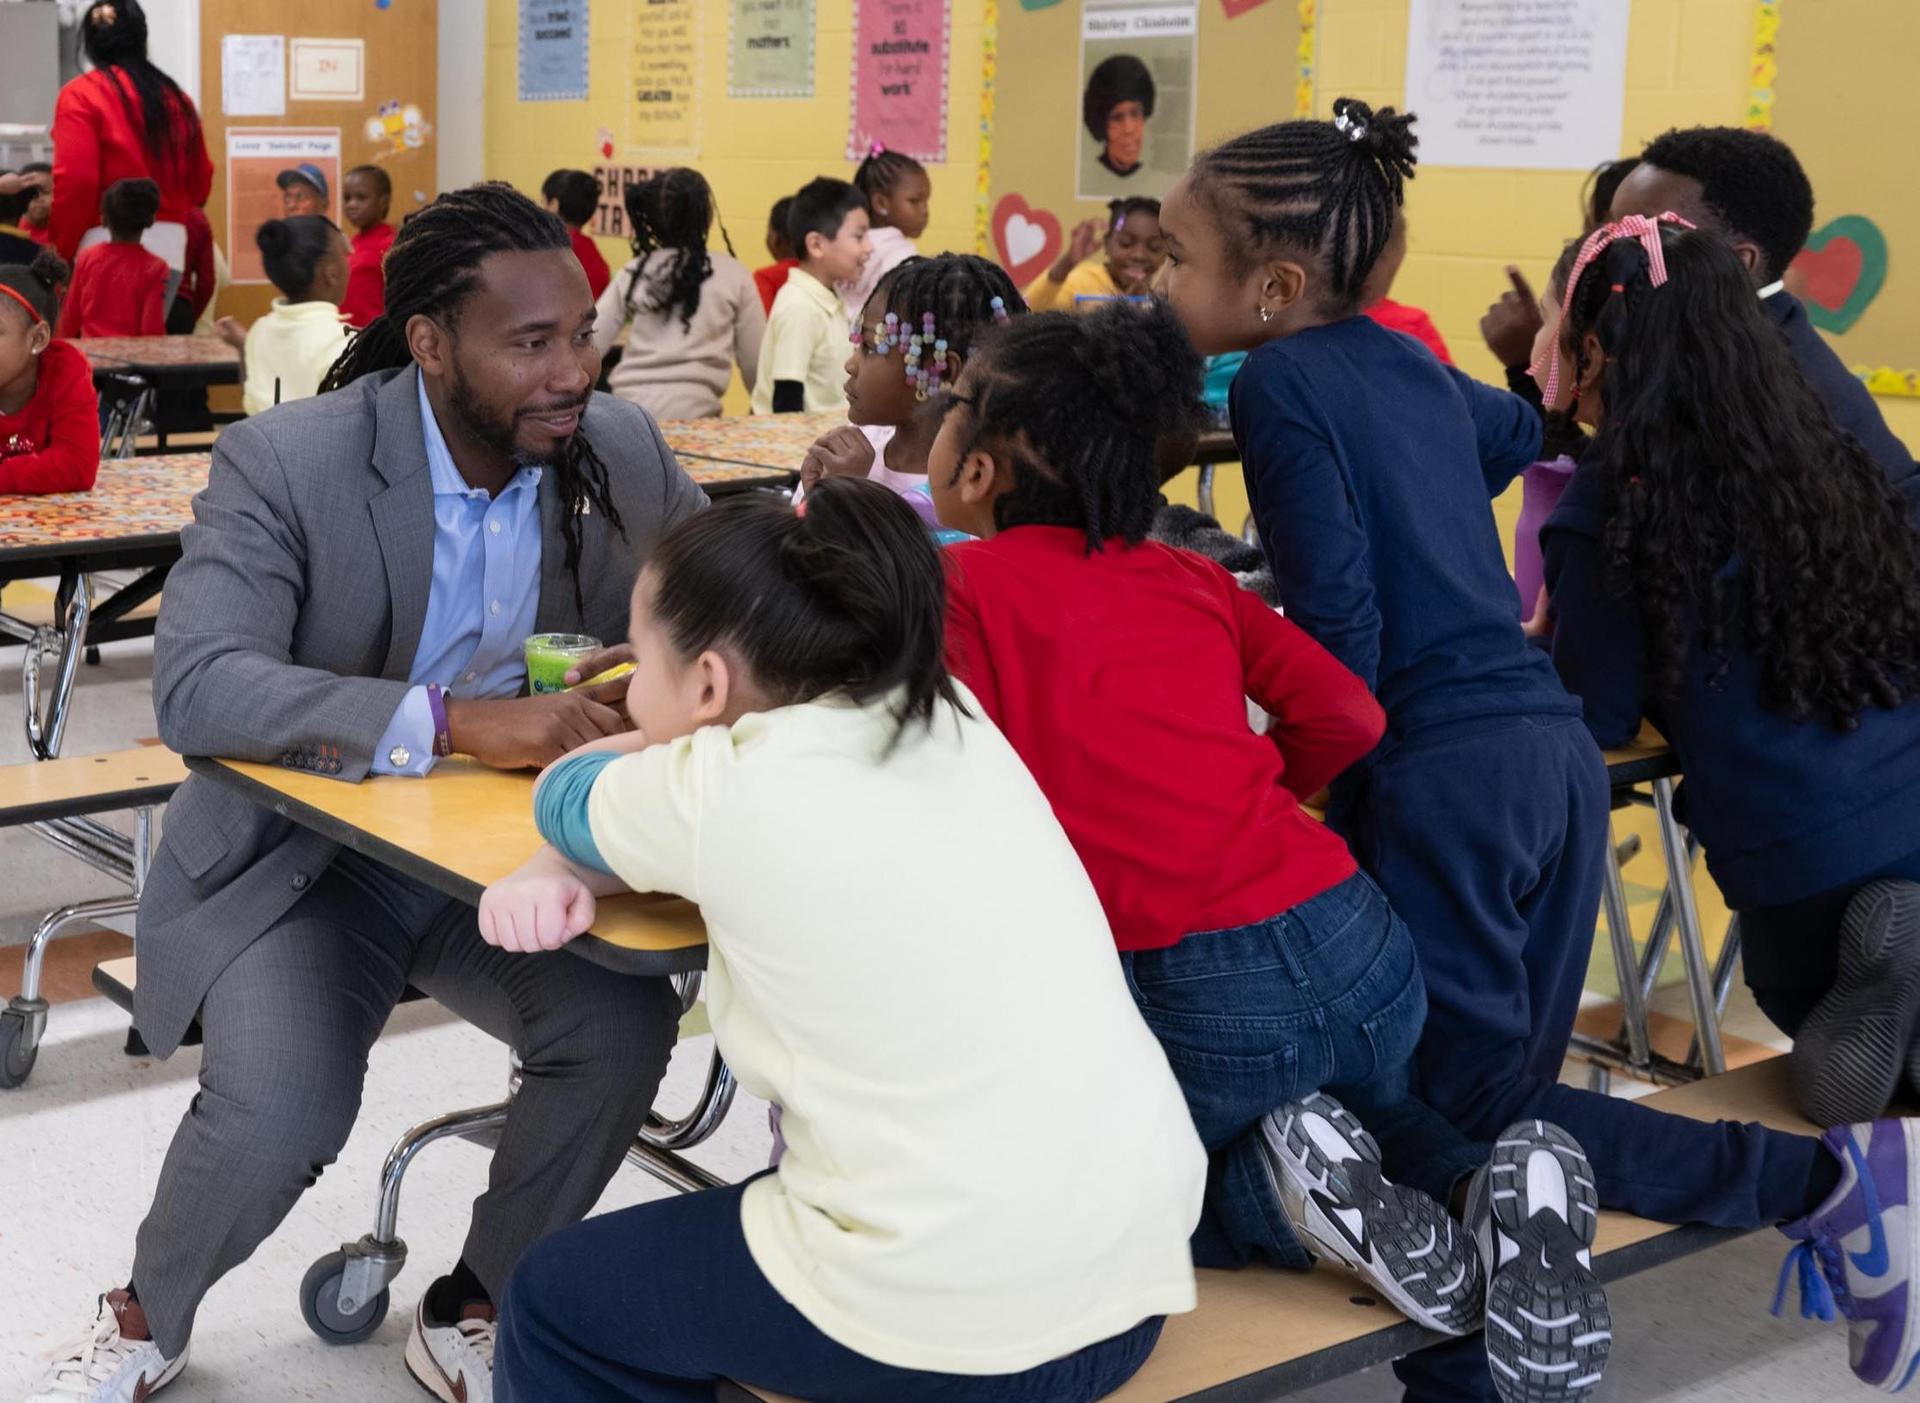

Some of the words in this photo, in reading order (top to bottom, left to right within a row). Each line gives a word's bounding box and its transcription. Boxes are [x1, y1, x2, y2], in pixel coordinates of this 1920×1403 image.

[1087, 17, 1127, 33] Shirley
[1133, 15, 1190, 29] Chisholm
[871, 38, 929, 55] substitute
